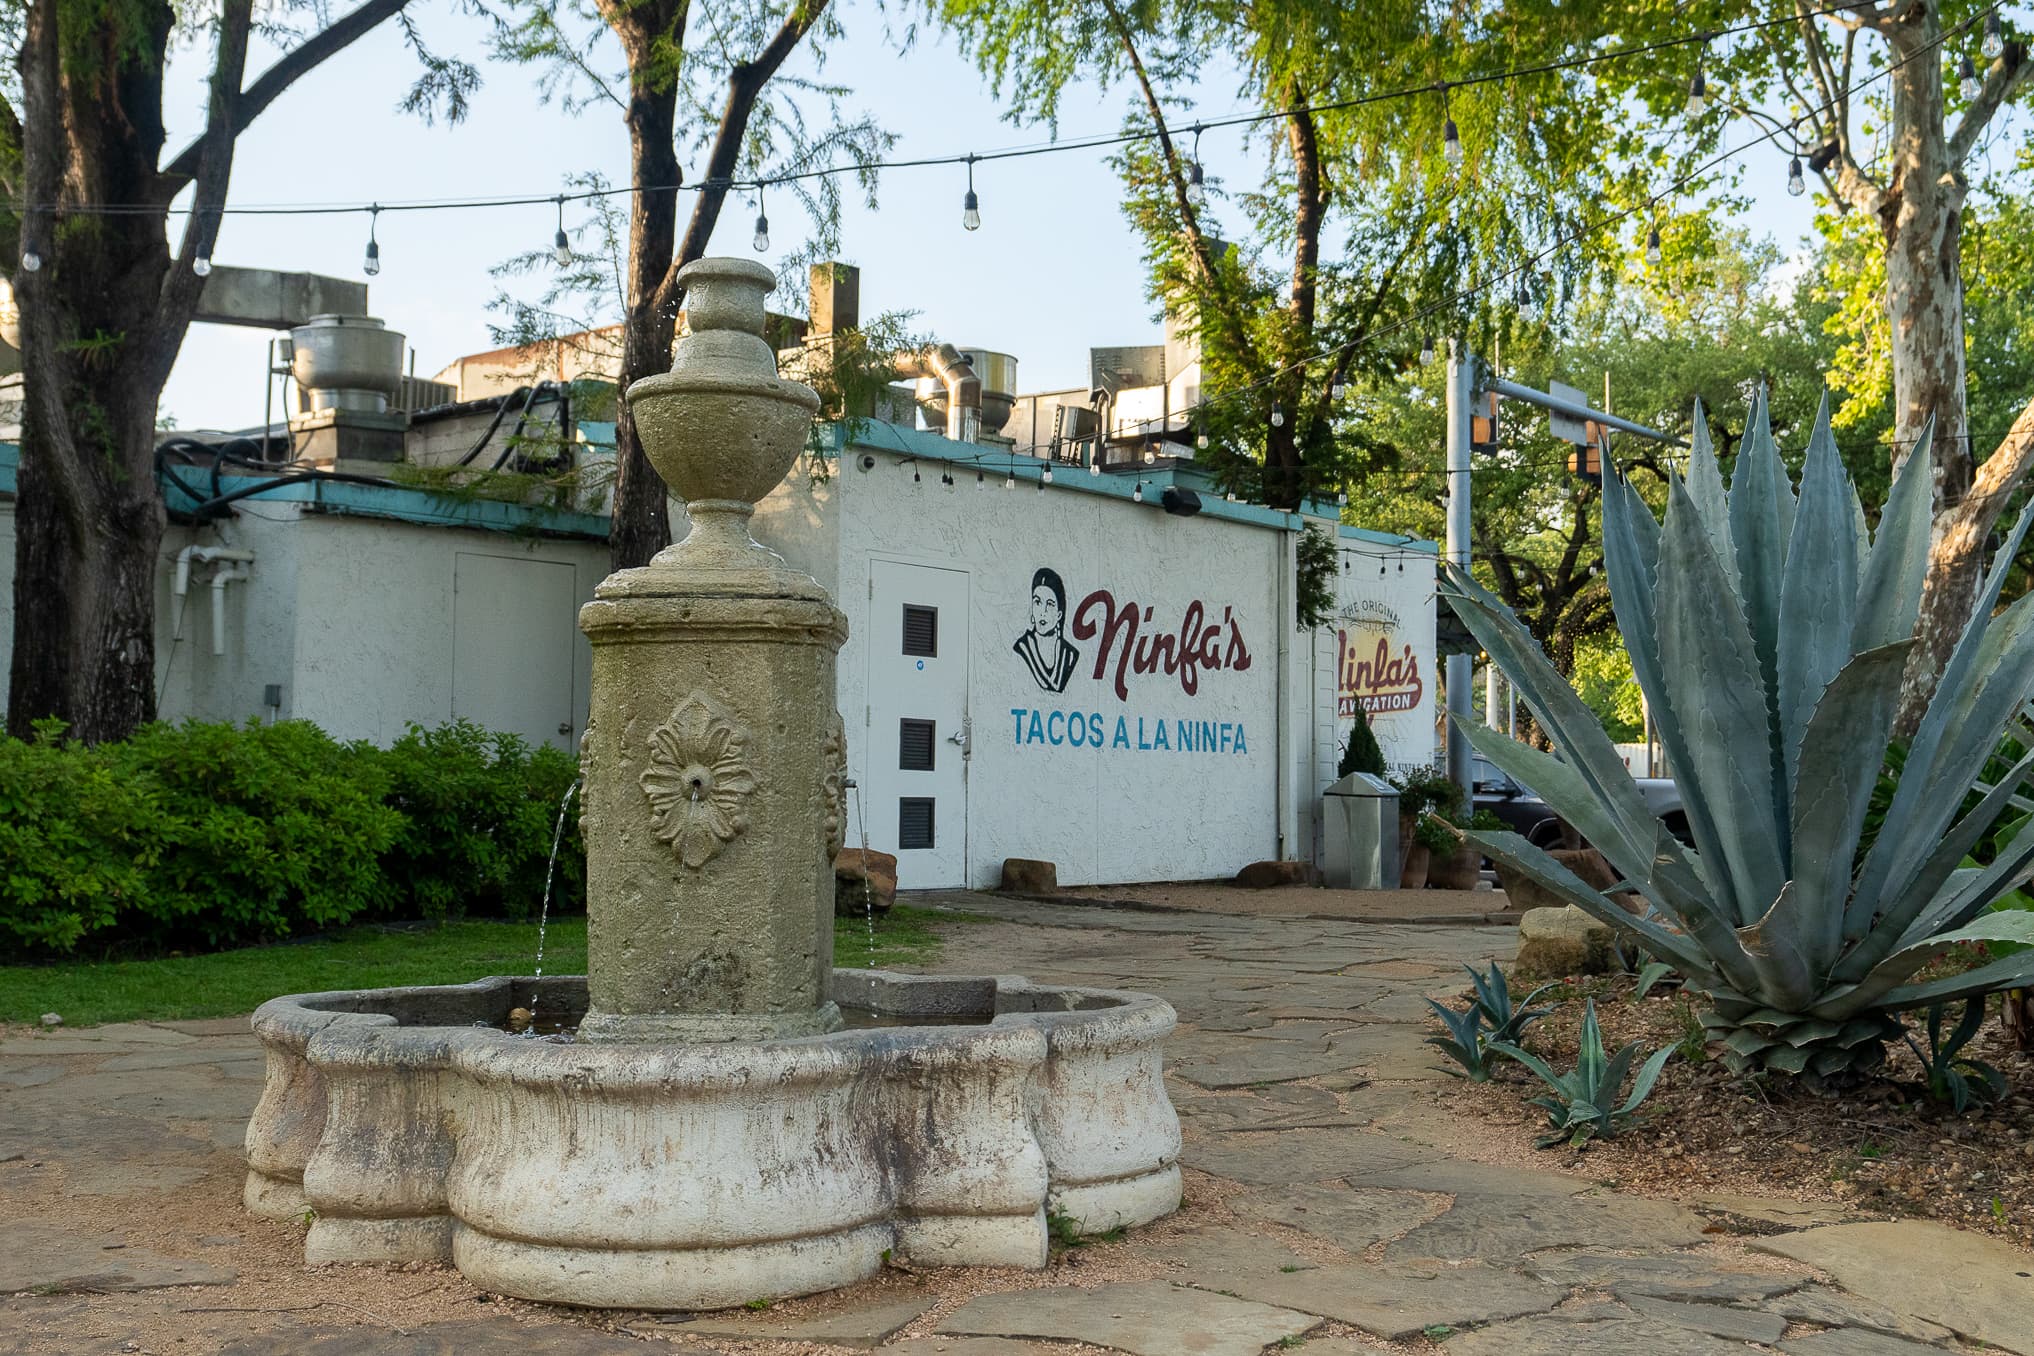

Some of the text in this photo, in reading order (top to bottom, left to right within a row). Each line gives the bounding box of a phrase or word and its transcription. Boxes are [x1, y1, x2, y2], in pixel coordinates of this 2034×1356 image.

[1342, 600, 1402, 630] THE ORIGINAL
[1072, 589, 1251, 702] Ninfa's
[1010, 709, 1248, 755] TACOS A LA NINFA
